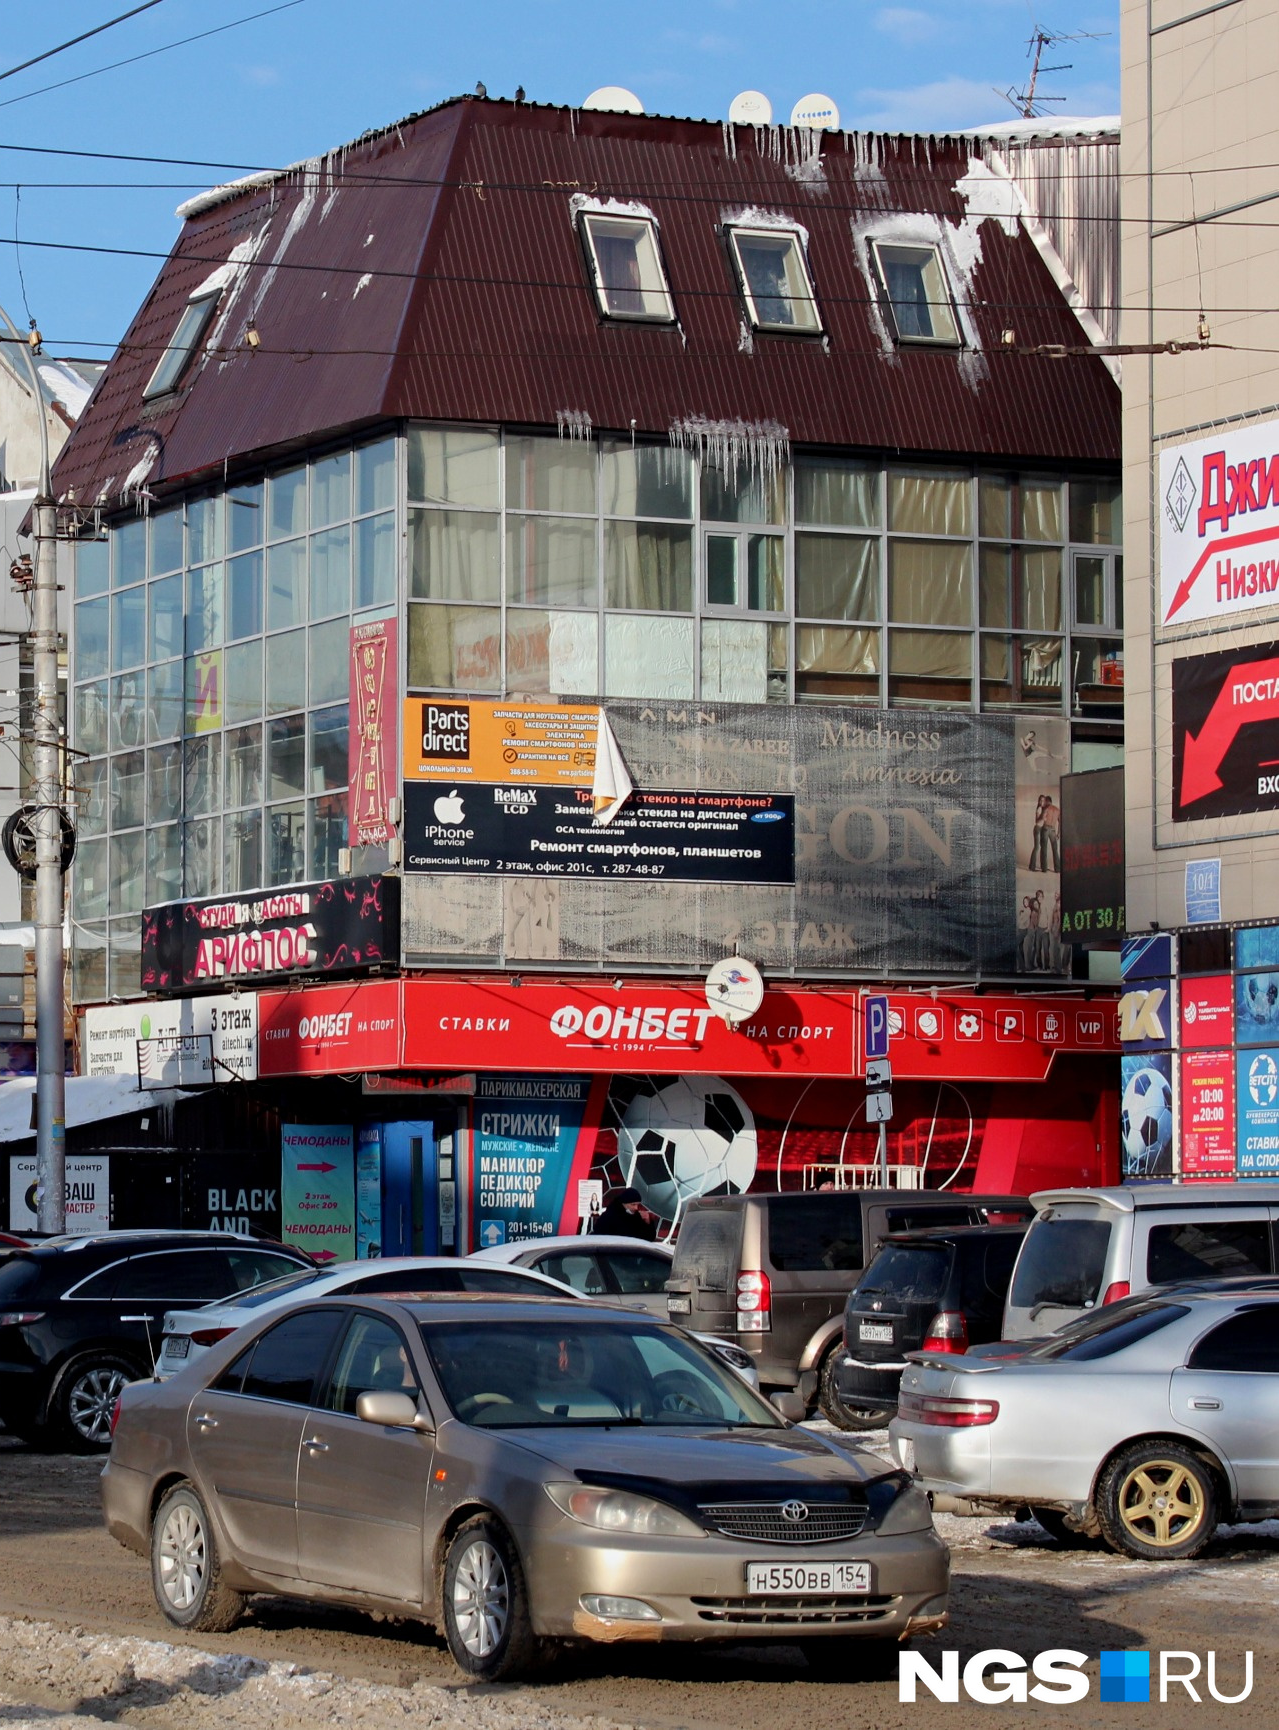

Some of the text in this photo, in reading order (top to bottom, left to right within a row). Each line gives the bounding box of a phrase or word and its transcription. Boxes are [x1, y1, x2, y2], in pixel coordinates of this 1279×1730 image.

[428, 706, 470, 731] Parts
[493, 711, 523, 719] ЗАПЧАСТИ
[423, 731, 468, 752] direct
[545, 731, 585, 739] ЭЛЕКТРИКА
[821, 721, 942, 752] Madness
[502, 739, 529, 747] РЕМОНТ
[517, 753, 547, 761] ГАРАНТИЯ
[418, 764, 473, 774] ЦОКОЛЬНЫЙ ЭТАЖ
[494, 787, 537, 804] ReMaX
[636, 794, 772, 808] стекло на смартфоне?
[503, 805, 529, 814] LCD
[555, 804, 747, 821] Замен стекла на дисплее
[425, 825, 474, 839] iPhone
[576, 827, 625, 835] технология
[639, 820, 739, 831] остается оригинал
[433, 838, 465, 847] service
[530, 839, 762, 858] Ремонт смартфонов, планшетов
[408, 854, 490, 867] Сервисный Центр
[496, 860, 503, 869] 2
[505, 862, 534, 873] этаж,
[536, 861, 564, 876] офис
[612, 864, 665, 875] 287-48-87
[1193, 871, 1214, 891] 10/1
[1074, 908, 1093, 930] ОТ
[752, 920, 858, 950] ЭТАЖ
[211, 1007, 252, 1032] 3 этаж
[265, 1012, 395, 1040] СТАВКИ ФОНБЕТ НА СПОРТ
[439, 1005, 834, 1041] СТАВКИ ФОНБЕТ НА СПОРТ
[90, 1026, 136, 1041] Ремонт ноутбуков
[1079, 1021, 1101, 1034] VIP
[1043, 1032, 1059, 1040] БАР
[623, 1043, 644, 1051] 1994
[90, 1052, 112, 1063] Запчасти
[1249, 1074, 1278, 1086] BETCITY
[480, 1080, 581, 1099] ПАРИКМАХЕРСКАЯ
[1200, 1089, 1223, 1103] 10:00
[1200, 1107, 1224, 1121] 20:00
[480, 1112, 561, 1137] СТРИЖКИ
[283, 1135, 350, 1147] ЧЕМОДАНЫ
[481, 1140, 560, 1153] МУЖСКИЕ ЖЕНСКИЕ
[74, 1163, 102, 1172] центр
[480, 1157, 545, 1174] МАНИКЮР
[1241, 1154, 1255, 1167] НА
[480, 1174, 542, 1192] ПЕДИКЮР
[64, 1183, 95, 1201] ВАШ
[305, 1192, 311, 1200] 2
[480, 1190, 535, 1208] СОЛЯРИЙ
[208, 1188, 277, 1212] BLACK
[298, 1201, 338, 1211] Офис 209
[209, 1216, 250, 1237] AND
[284, 1224, 352, 1236] ЧЕМОДАНЫ
[836, 1565, 866, 1583] 154
